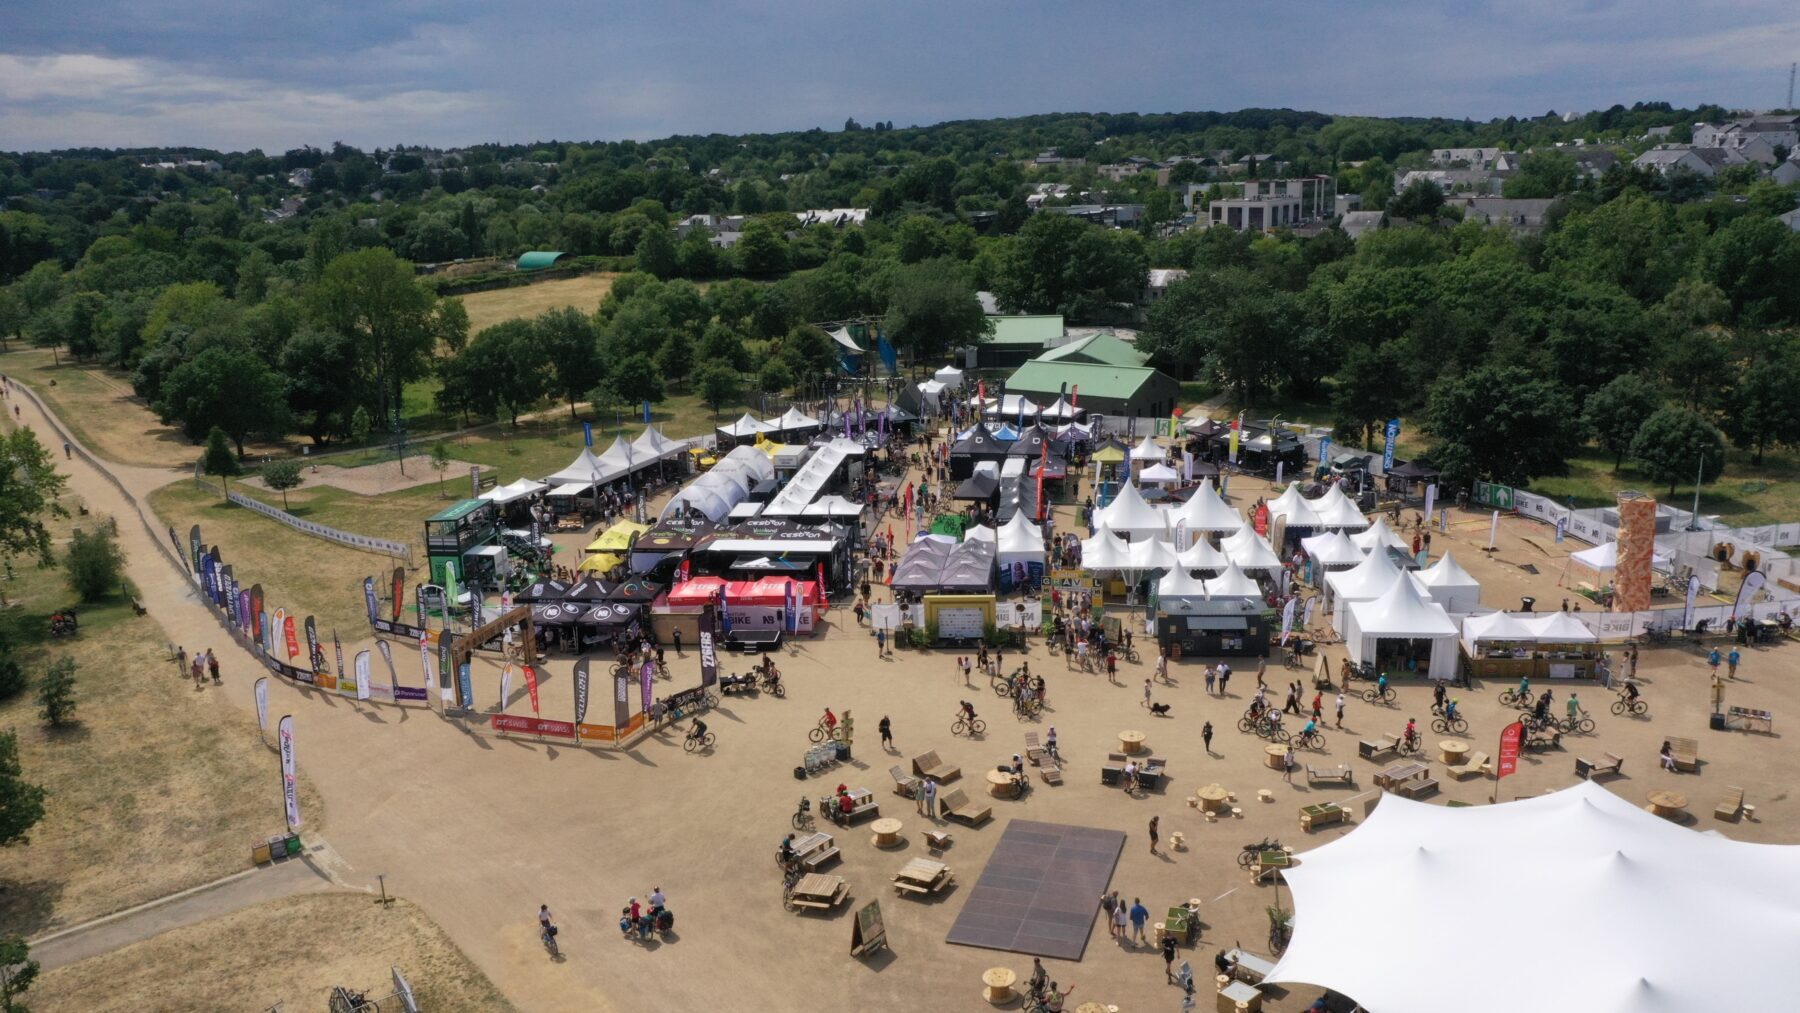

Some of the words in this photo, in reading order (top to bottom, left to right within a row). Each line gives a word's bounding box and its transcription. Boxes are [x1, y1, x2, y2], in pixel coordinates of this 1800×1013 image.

[1384, 424, 1397, 469] DECATHLON
[763, 615, 775, 624] NB
[700, 631, 715, 667] 226ERS
[578, 670, 587, 721] SPECIALIZED
